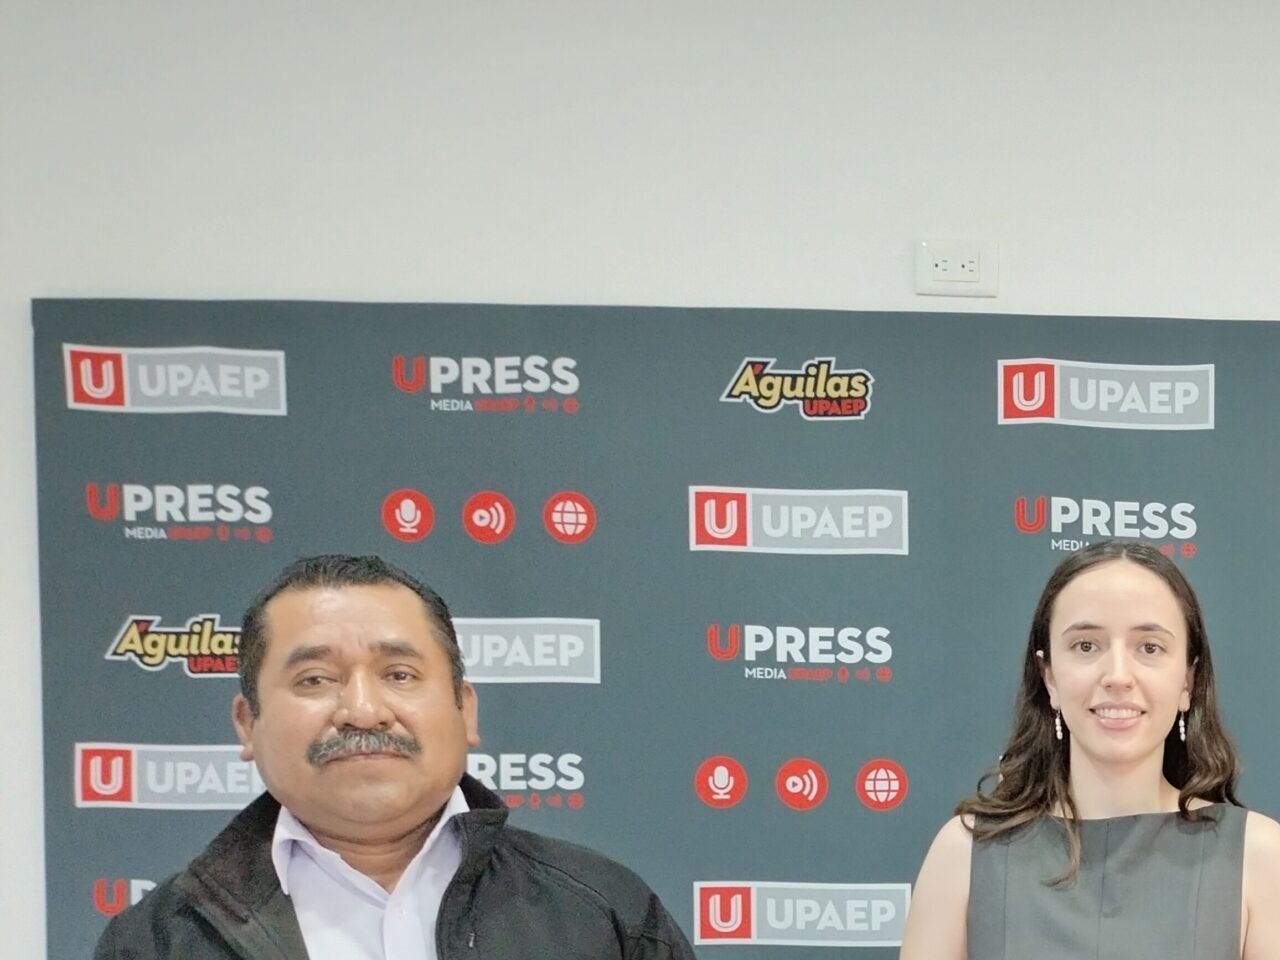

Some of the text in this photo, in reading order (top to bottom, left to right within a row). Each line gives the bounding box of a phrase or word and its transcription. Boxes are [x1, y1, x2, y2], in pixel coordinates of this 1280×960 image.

[80, 357, 270, 398] U UPAEP
[392, 354, 580, 395] UPRESS
[730, 360, 868, 409] Águilas
[1013, 371, 1199, 414] U UPAEP
[431, 399, 473, 411] MEDIA
[804, 399, 866, 416] UPAEP
[86, 482, 272, 524] UPRESS
[704, 499, 893, 539] U UPAEP
[1015, 496, 1197, 540] UPRESS
[125, 527, 167, 539] MEDIA
[1050, 538, 1090, 552] MEDI
[114, 616, 241, 665] Águila
[708, 624, 893, 663] UPRESS
[189, 656, 240, 672] UPAE
[744, 667, 786, 680] MEDIA
[90, 756, 123, 795] U
[466, 753, 586, 790] RESS
[709, 894, 895, 932] U UPAEP
